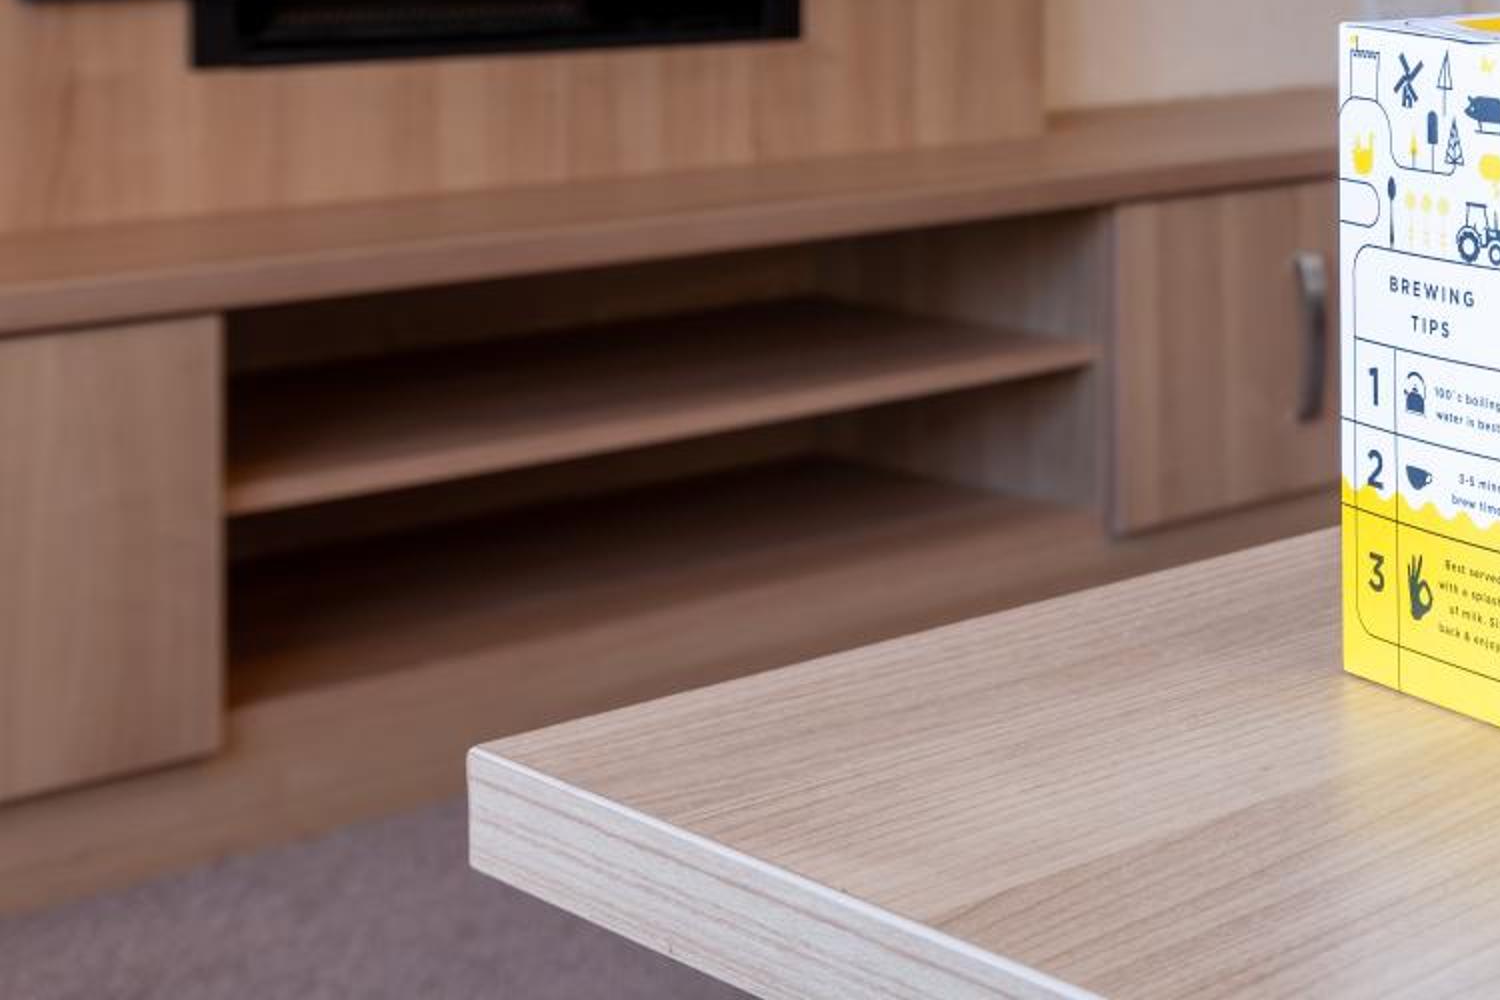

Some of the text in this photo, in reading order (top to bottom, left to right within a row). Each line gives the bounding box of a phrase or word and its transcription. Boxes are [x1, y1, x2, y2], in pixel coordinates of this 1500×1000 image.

[1389, 274, 1476, 307] BREWING
[1410, 314, 1451, 339] TIPS
[1368, 367, 1379, 407] 1
[1368, 449, 1384, 490] 2
[1368, 551, 1385, 593] 3
